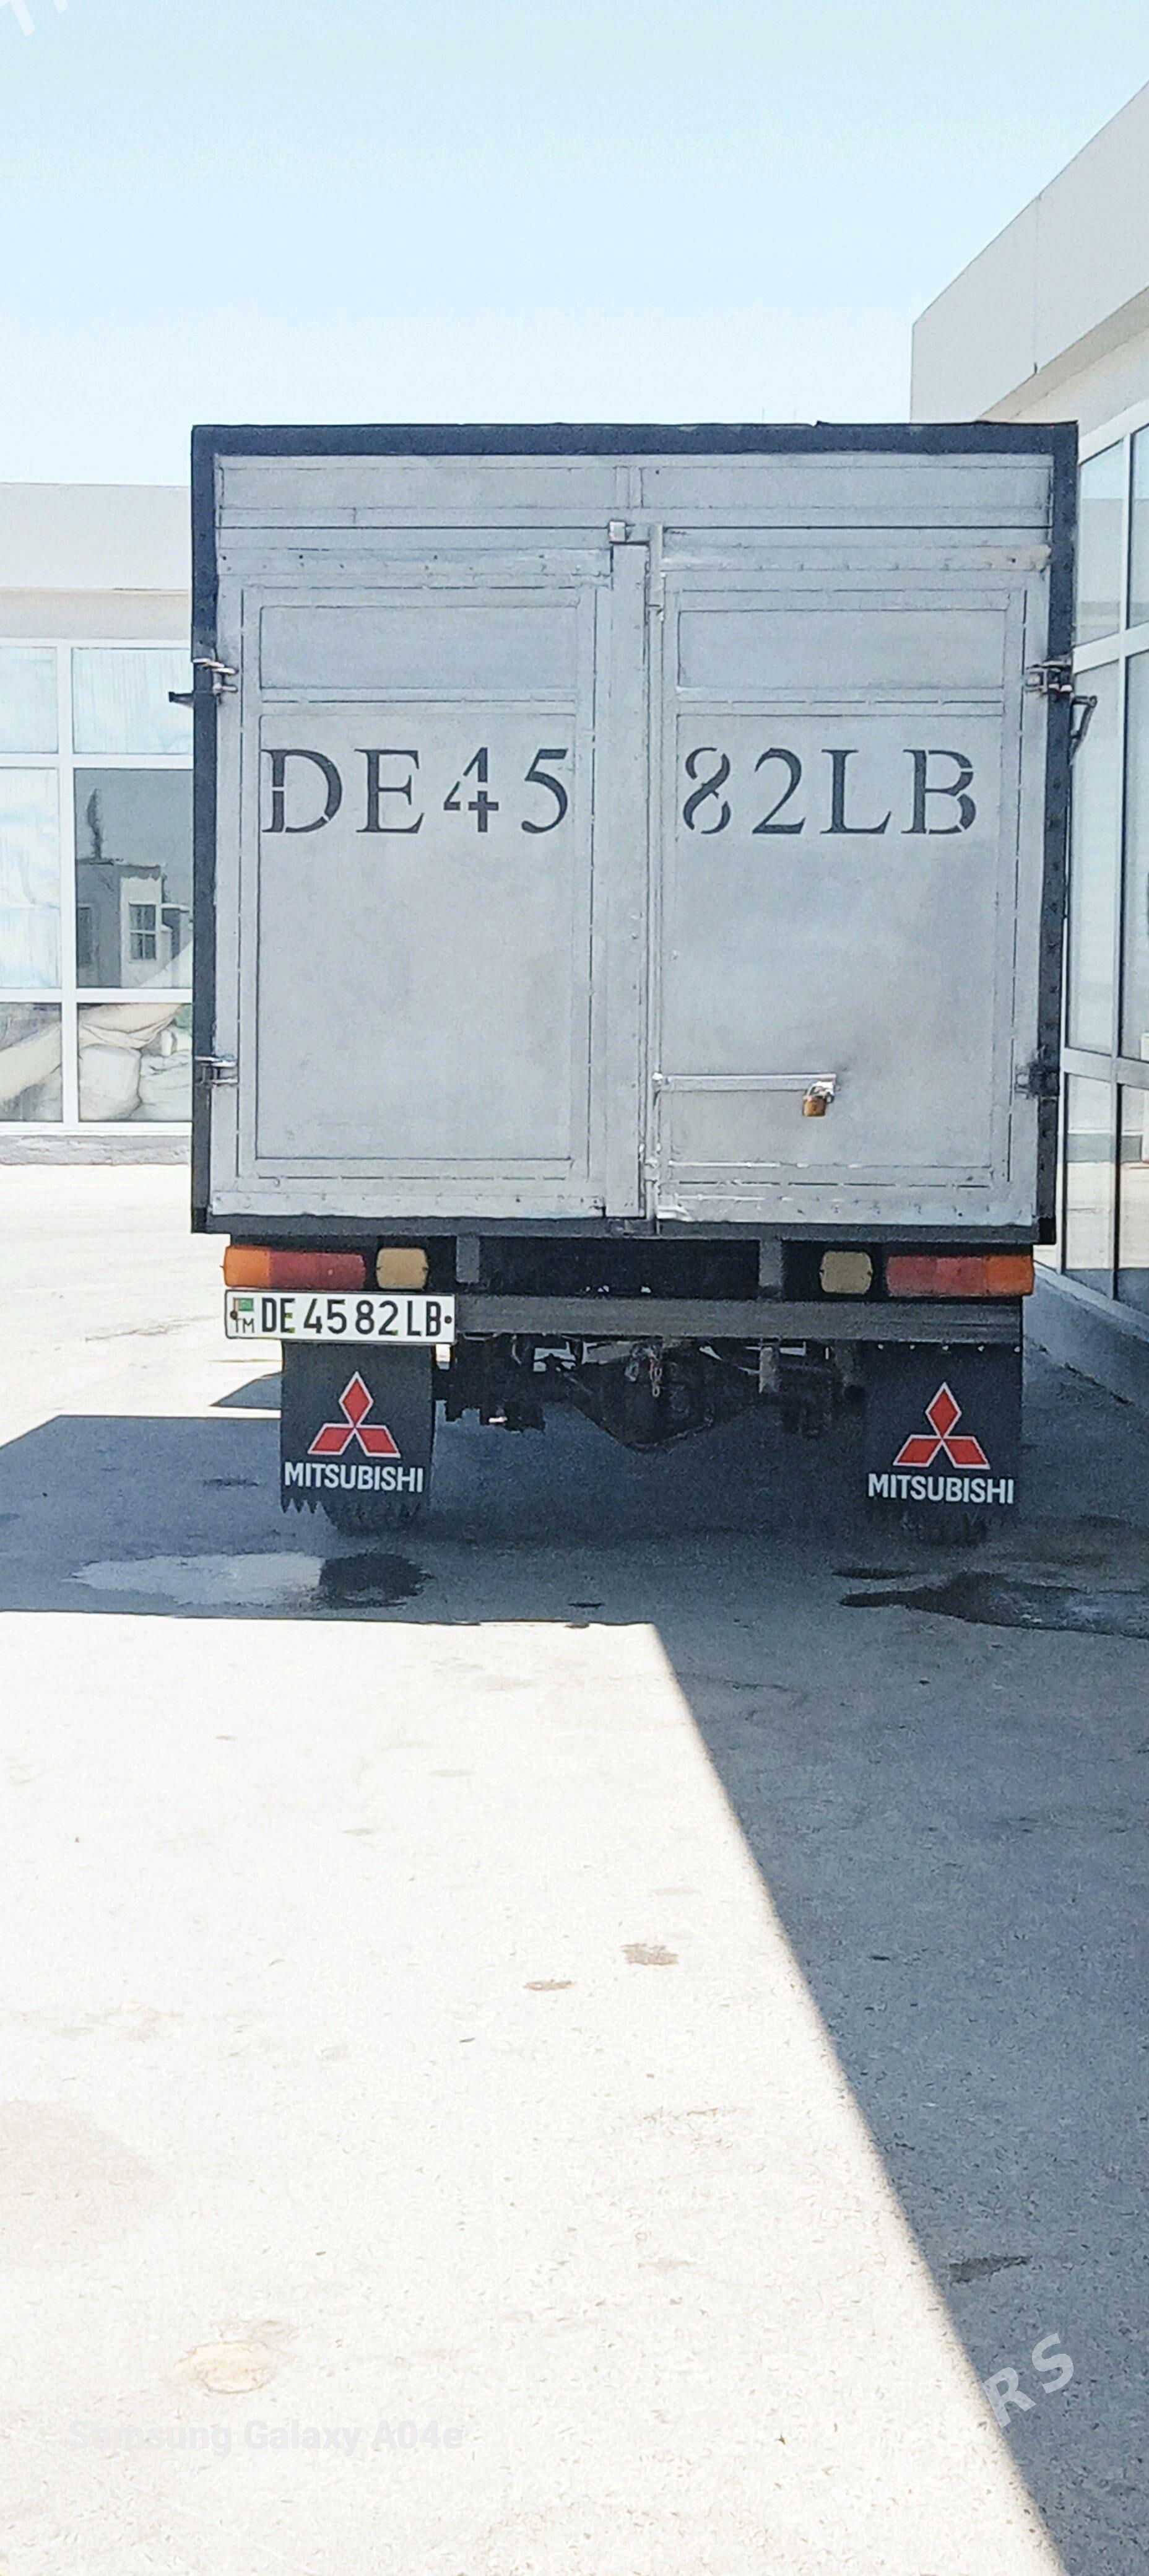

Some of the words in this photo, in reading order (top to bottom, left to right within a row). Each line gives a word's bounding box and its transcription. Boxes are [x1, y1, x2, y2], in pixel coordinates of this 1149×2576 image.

[261, 747, 568, 834] DE45
[683, 747, 976, 835] 82LB
[284, 1461, 423, 1492] MITSUBISHI
[868, 1473, 1014, 1505] MITSUBISHI
